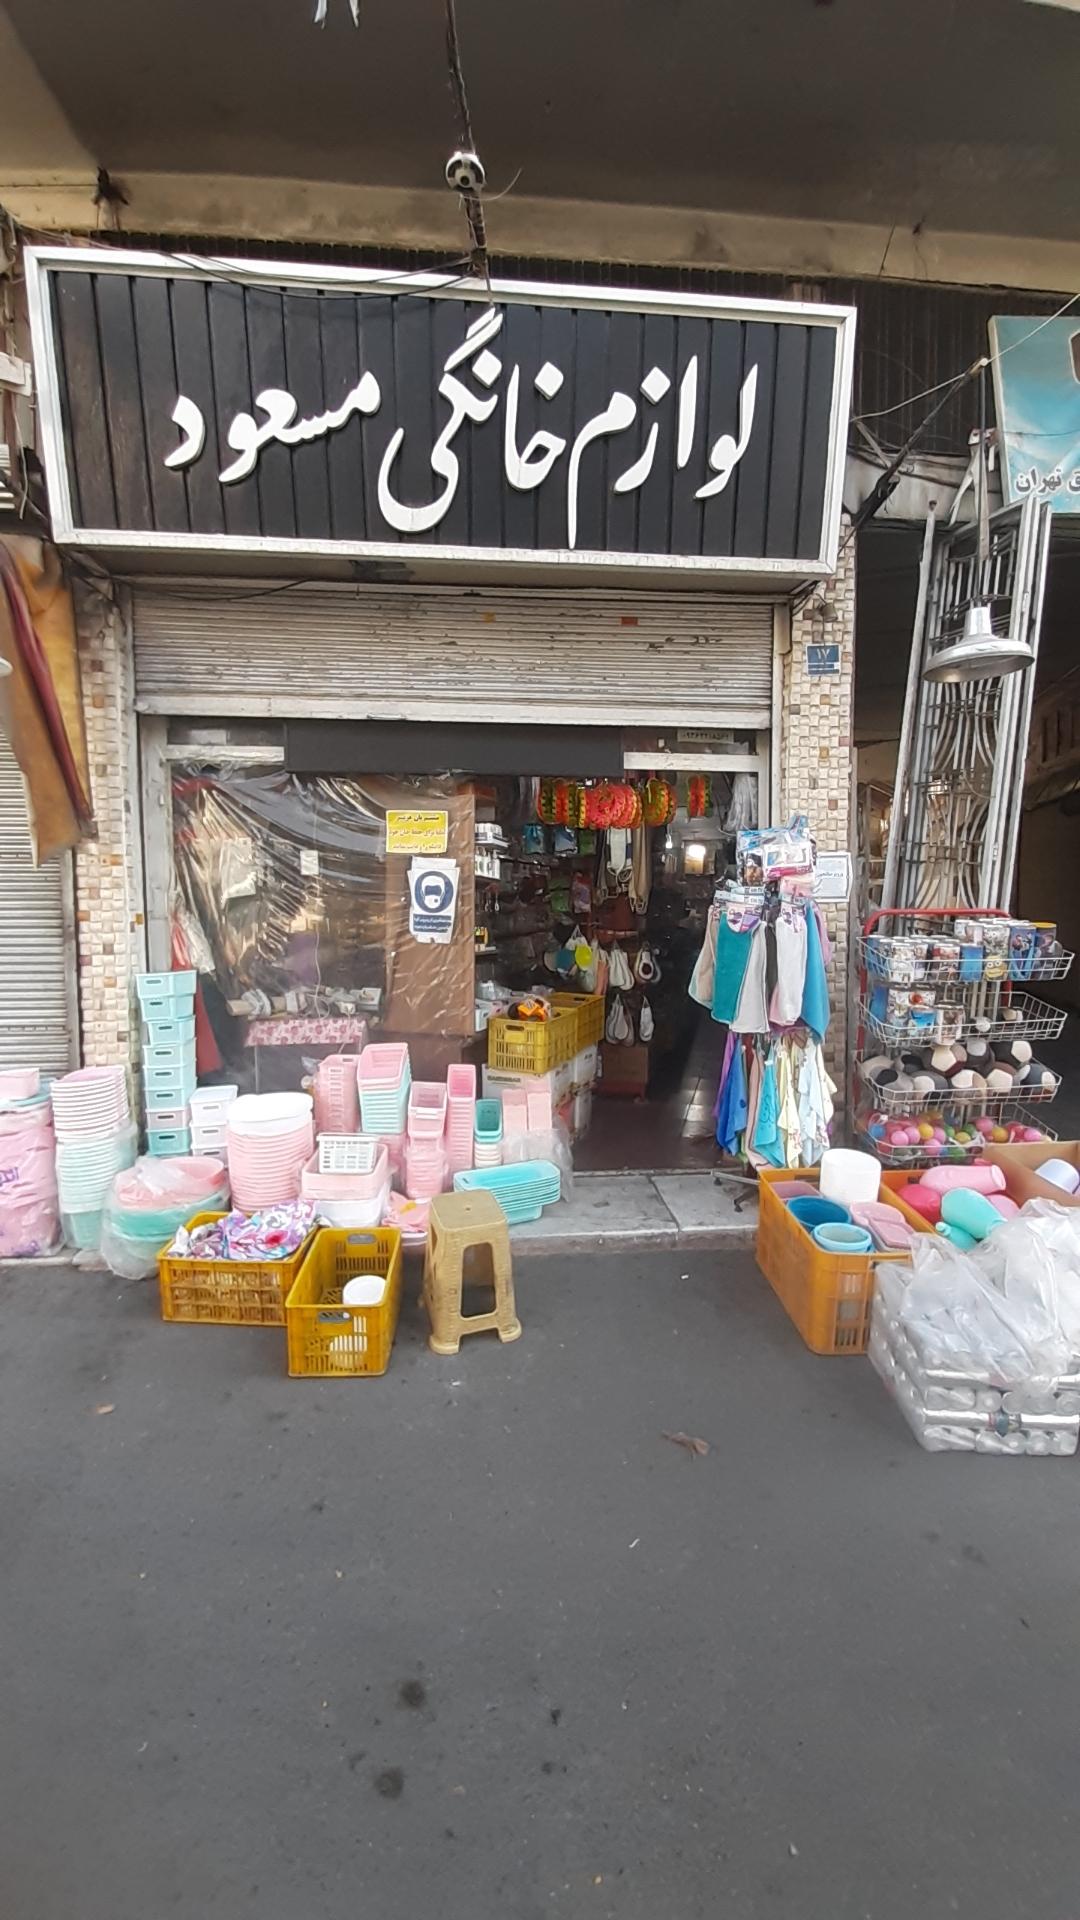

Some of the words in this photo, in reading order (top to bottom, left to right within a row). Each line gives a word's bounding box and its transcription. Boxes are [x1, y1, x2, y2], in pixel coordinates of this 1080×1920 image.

[163, 370, 381, 483] مسعود
[377, 306, 567, 533] خانگی
[567, 355, 759, 548] لوازم
[1015, 467, 1062, 494] تهران
